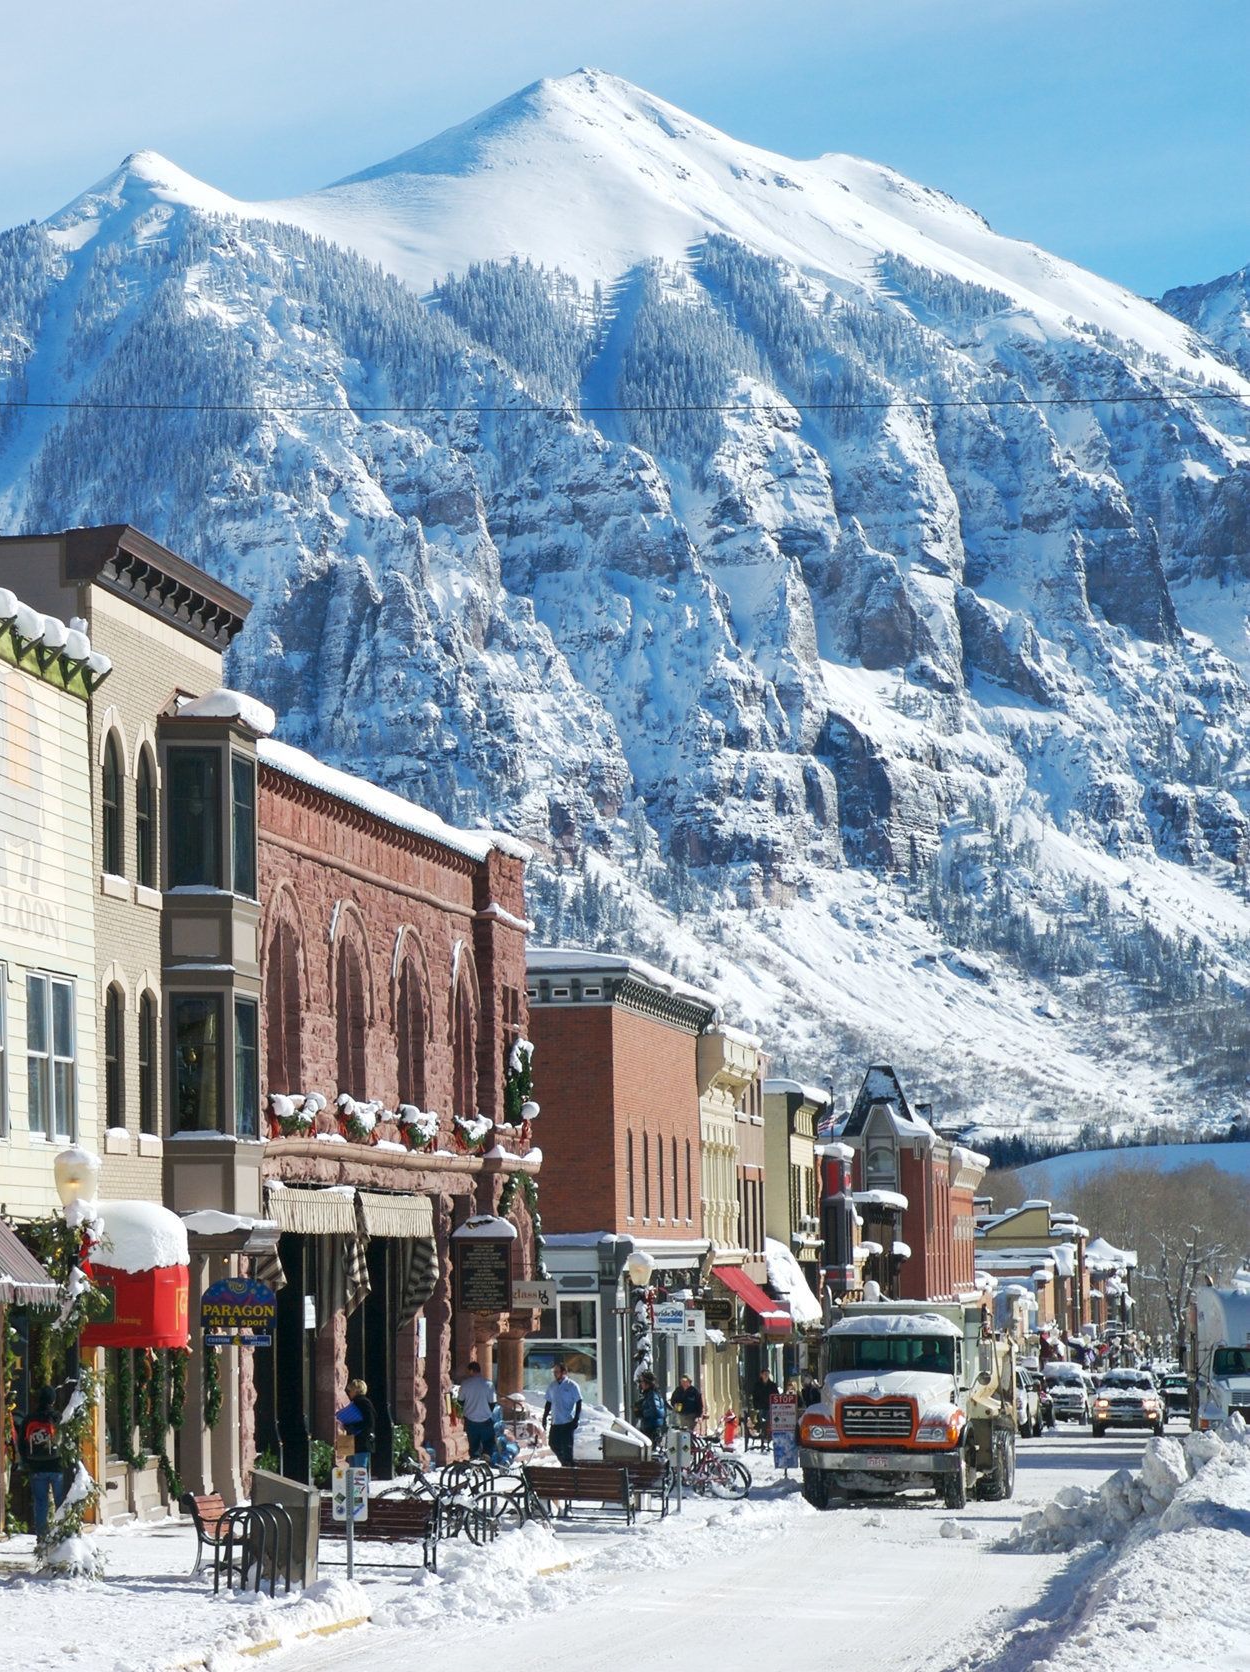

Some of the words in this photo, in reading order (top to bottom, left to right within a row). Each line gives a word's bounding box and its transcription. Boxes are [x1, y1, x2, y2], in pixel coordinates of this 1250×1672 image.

[202, 1304, 275, 1317] PARAGON
[209, 1317, 224, 1327] ski
[228, 1317, 238, 1327] &
[241, 1317, 267, 1329] sport
[773, 1395, 795, 1404] STOP
